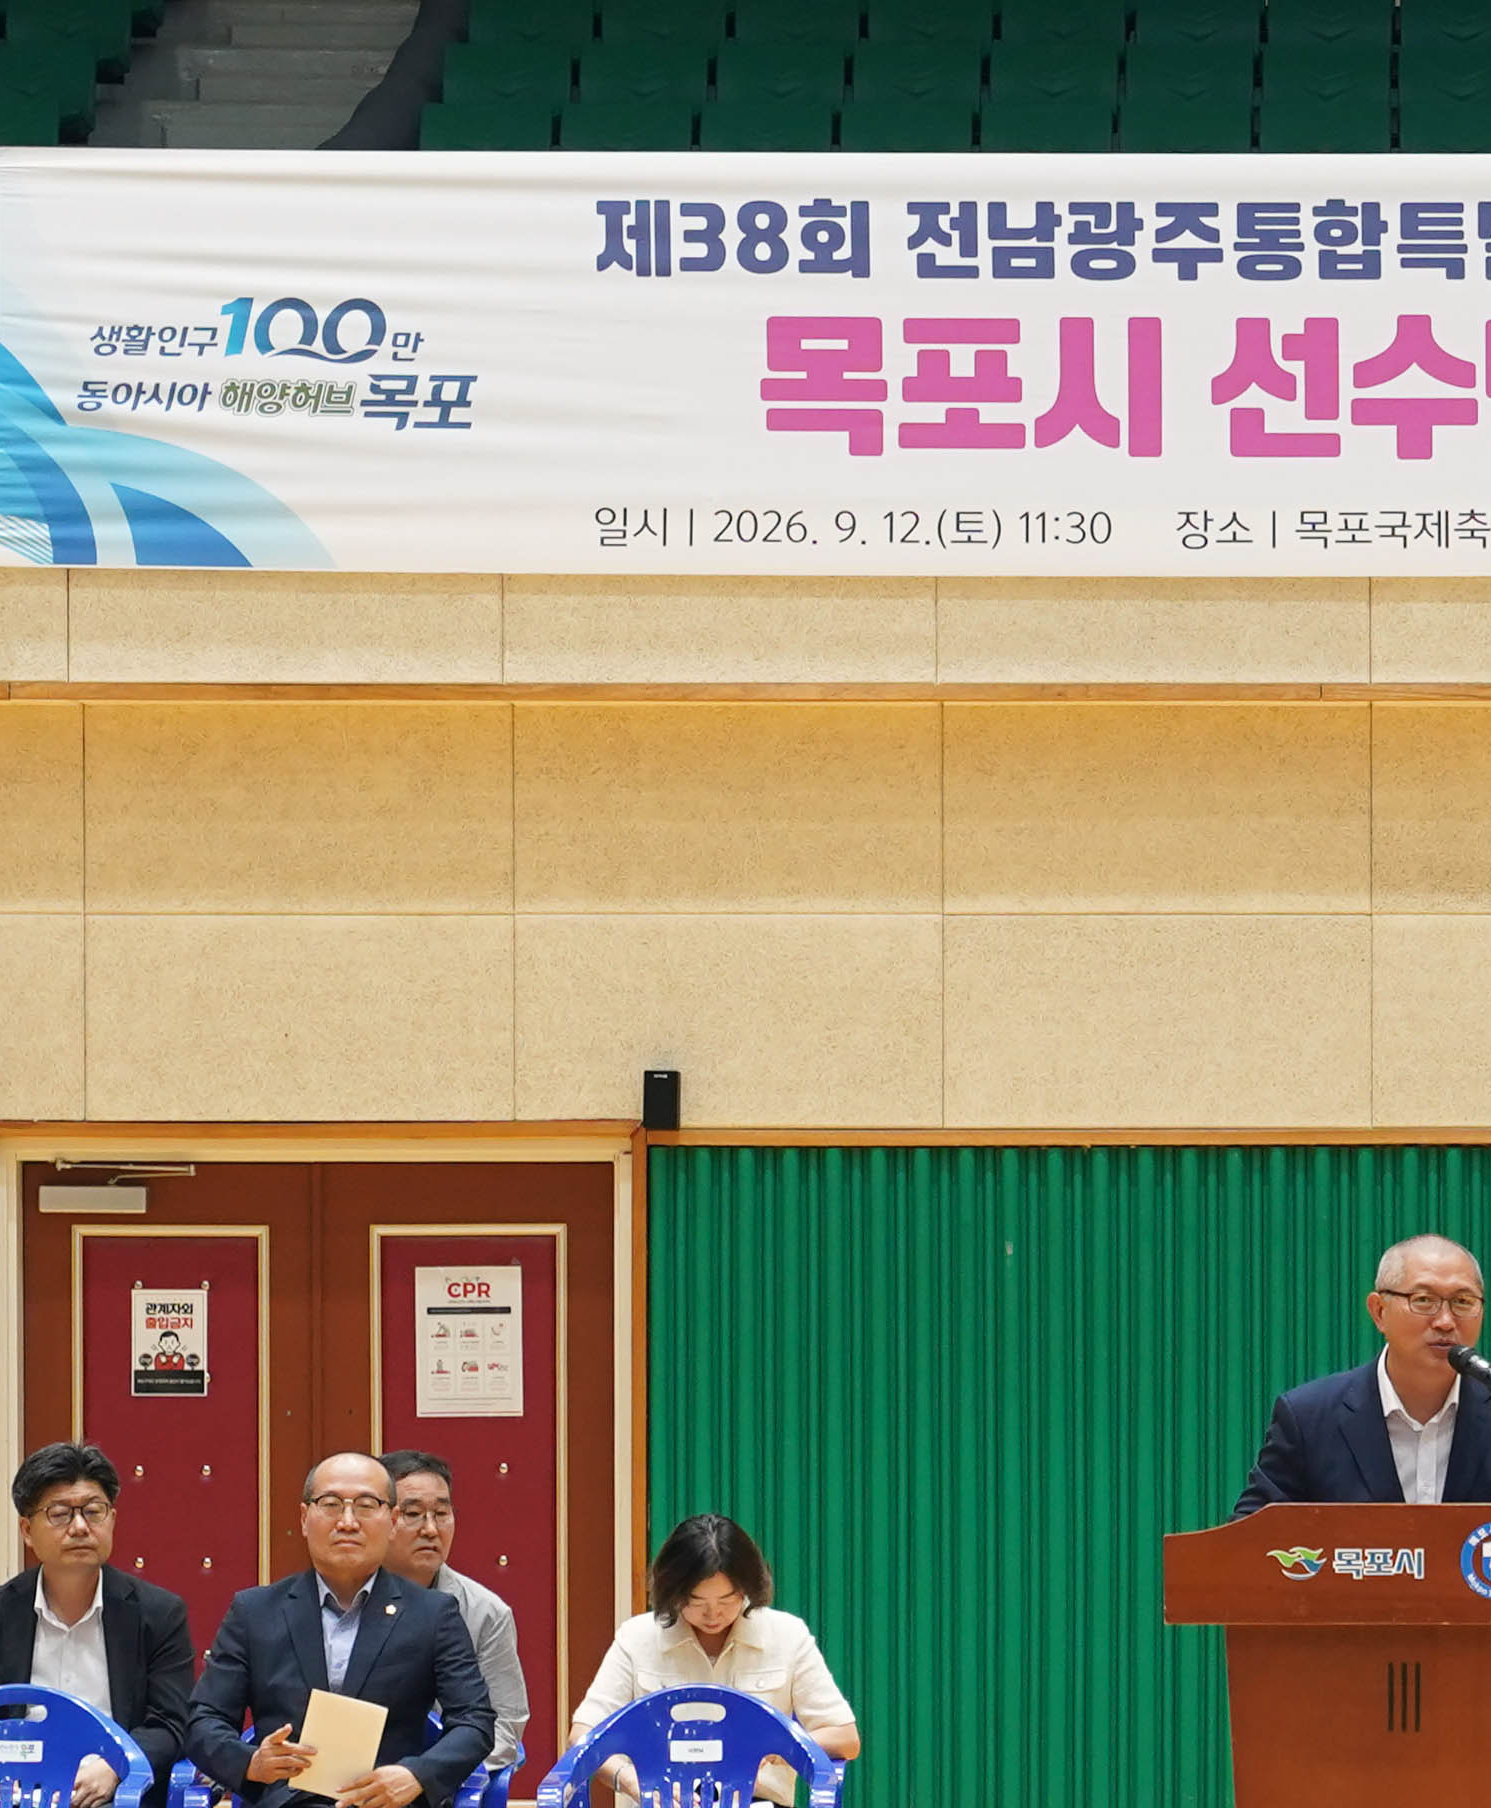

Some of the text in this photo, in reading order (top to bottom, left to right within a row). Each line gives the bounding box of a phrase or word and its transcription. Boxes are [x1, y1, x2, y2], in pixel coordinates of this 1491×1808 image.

[595, 197, 871, 279] 제38회
[89, 323, 219, 357] 생활인구
[75, 373, 479, 432] 동아시아 해양허브 목포
[759, 315, 1163, 458] 목포시
[594, 506, 668, 548] 일시
[712, 509, 818, 546] 2026.
[834, 509, 867, 546] 9.
[883, 508, 1002, 550] 12.(토)
[1018, 510, 1112, 546] 11:30
[1175, 508, 1254, 550] 장소
[145, 1303, 193, 1315] 관계자외
[447, 1282, 491, 1299] CPR
[145, 1317, 193, 1329] 출입금지
[1333, 1548, 1425, 1579] 목포시
